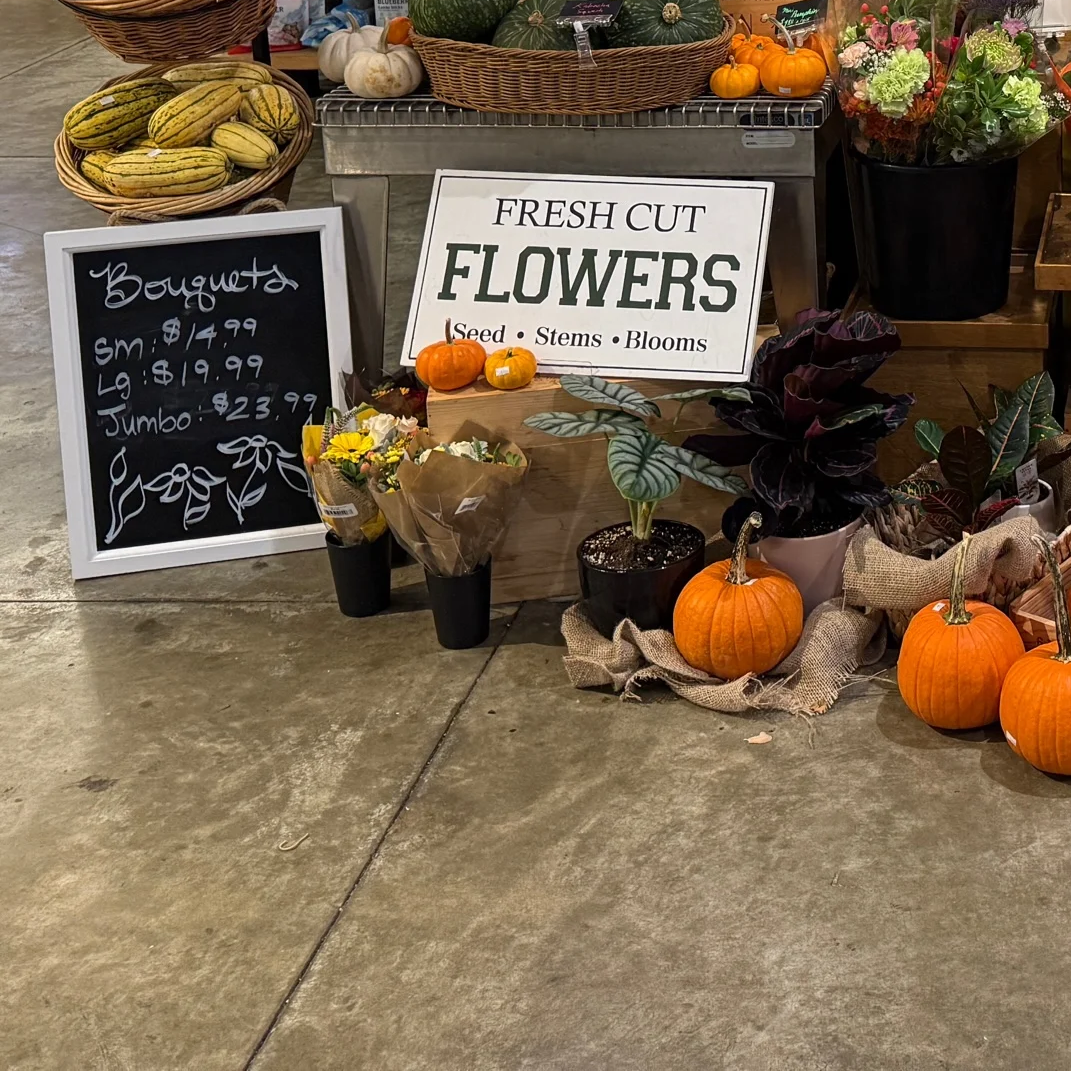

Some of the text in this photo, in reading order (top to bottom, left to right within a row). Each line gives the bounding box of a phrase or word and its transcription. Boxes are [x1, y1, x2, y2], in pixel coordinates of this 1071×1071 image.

[492, 198, 706, 233] FRESH CUT
[89, 257, 299, 312] Bouquets
[437, 242, 741, 313] FLOWERS
[162, 317, 257, 351] $14.99
[452, 322, 708, 353] Seed Stems Blooms
[152, 354, 264, 386] $19.99
[211, 390, 318, 422] $23.99
